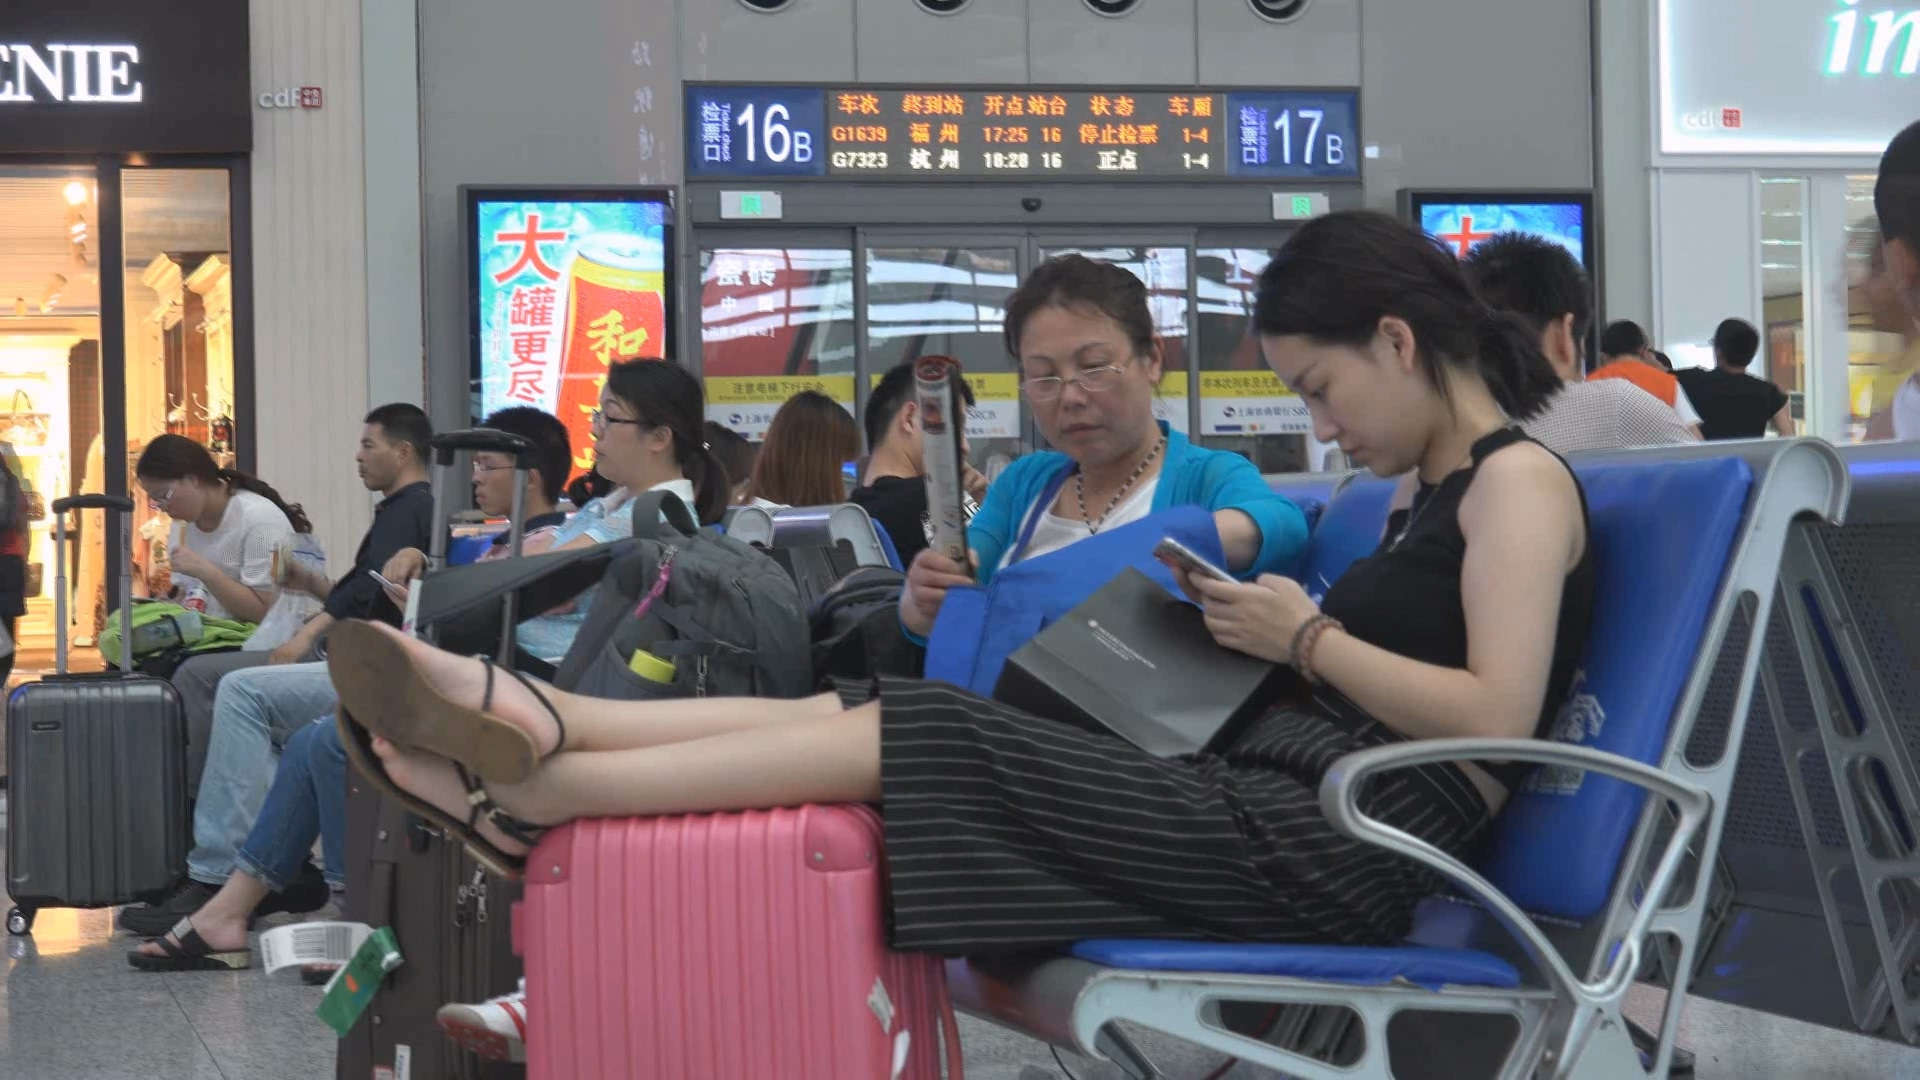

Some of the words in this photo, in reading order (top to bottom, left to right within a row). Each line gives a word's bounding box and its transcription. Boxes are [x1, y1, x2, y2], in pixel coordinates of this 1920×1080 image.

[838, 94, 880, 115] 车次
[902, 94, 965, 116] 终到站
[984, 95, 1024, 116] 开点
[1027, 95, 1067, 116] 站台
[1090, 95, 1134, 117] 状态
[832, 126, 888, 143] G1639
[983, 126, 1030, 144] 17:25
[1041, 127, 1062, 144] 16
[1078, 124, 1159, 145] 停止检票
[1182, 127, 1209, 144] 1-4
[831, 151, 889, 169] G7323
[1041, 152, 1062, 169] 16
[1097, 149, 1138, 171] 正点
[1182, 152, 1209, 170] 1-4
